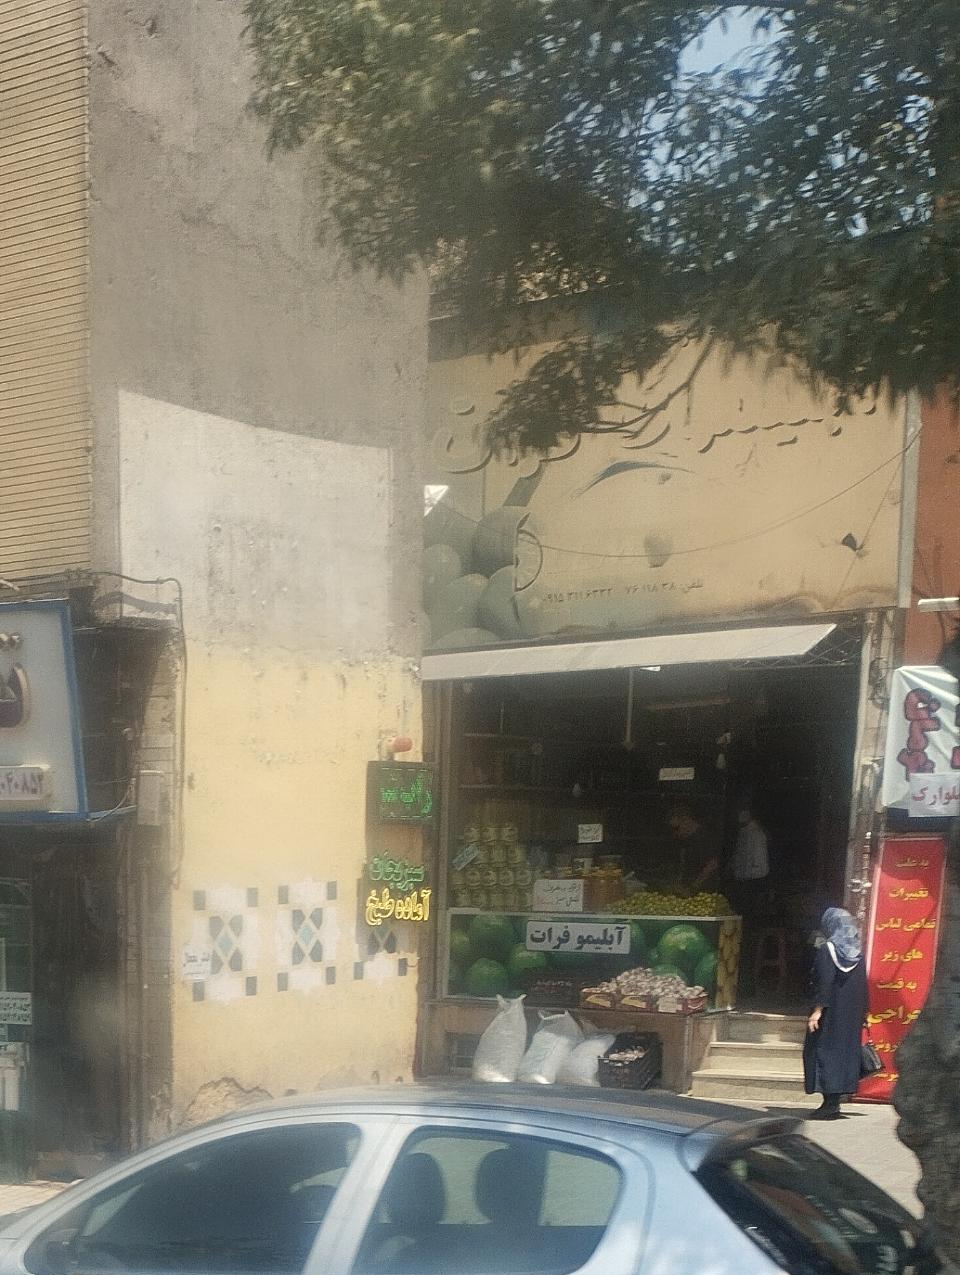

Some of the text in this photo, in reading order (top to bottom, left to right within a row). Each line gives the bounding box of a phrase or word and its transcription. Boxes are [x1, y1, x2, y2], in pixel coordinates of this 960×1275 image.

[911, 784, 960, 807] لوارک
[394, 887, 432, 922] آماده
[529, 925, 627, 950] آبلیمو فرات
